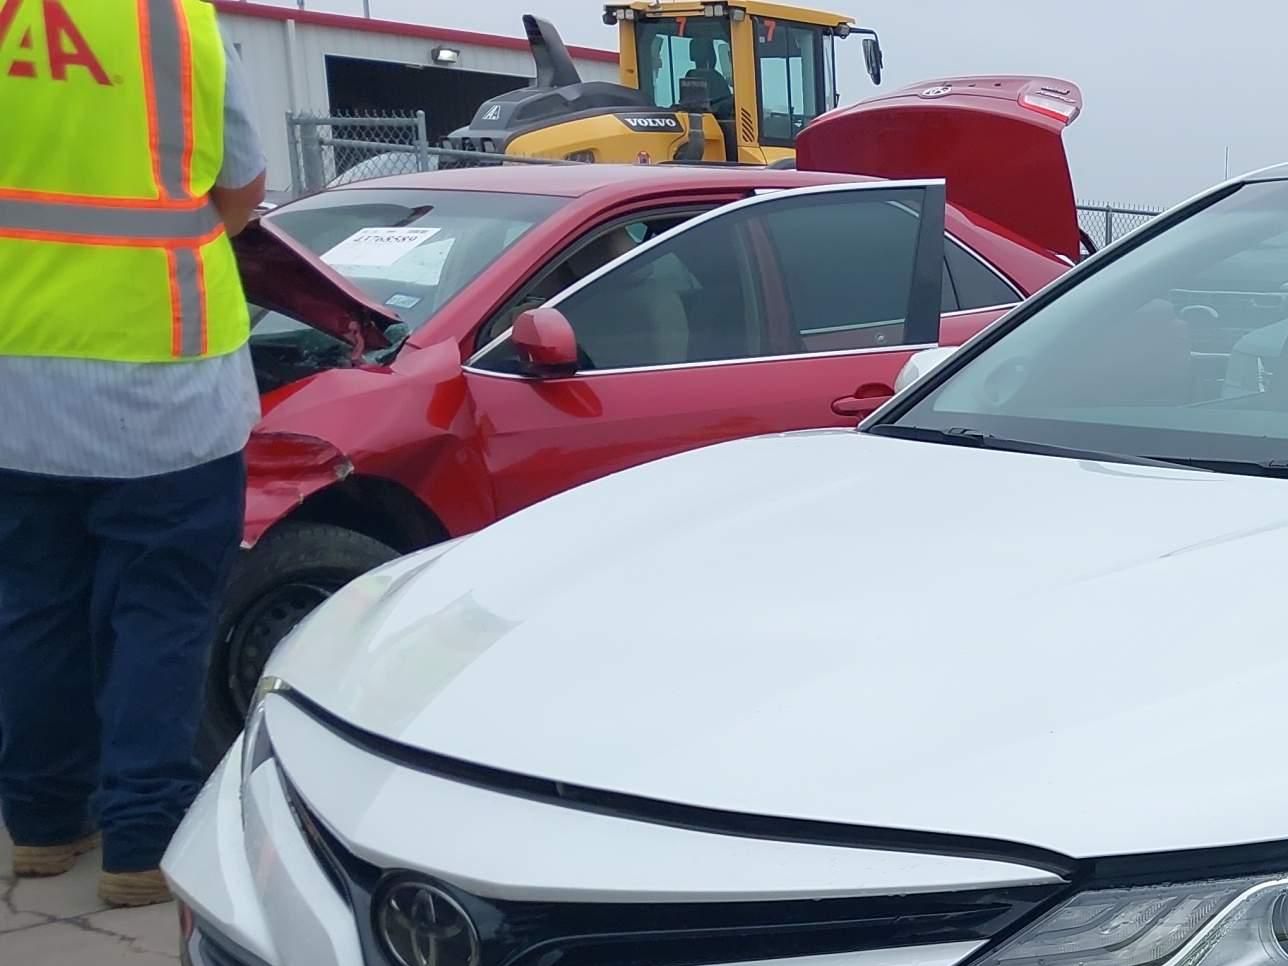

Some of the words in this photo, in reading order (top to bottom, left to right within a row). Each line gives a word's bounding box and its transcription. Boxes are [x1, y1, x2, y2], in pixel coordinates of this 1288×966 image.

[675, 17, 687, 36] 7
[763, 19, 776, 42] 7
[626, 117, 677, 128] VOLVO
